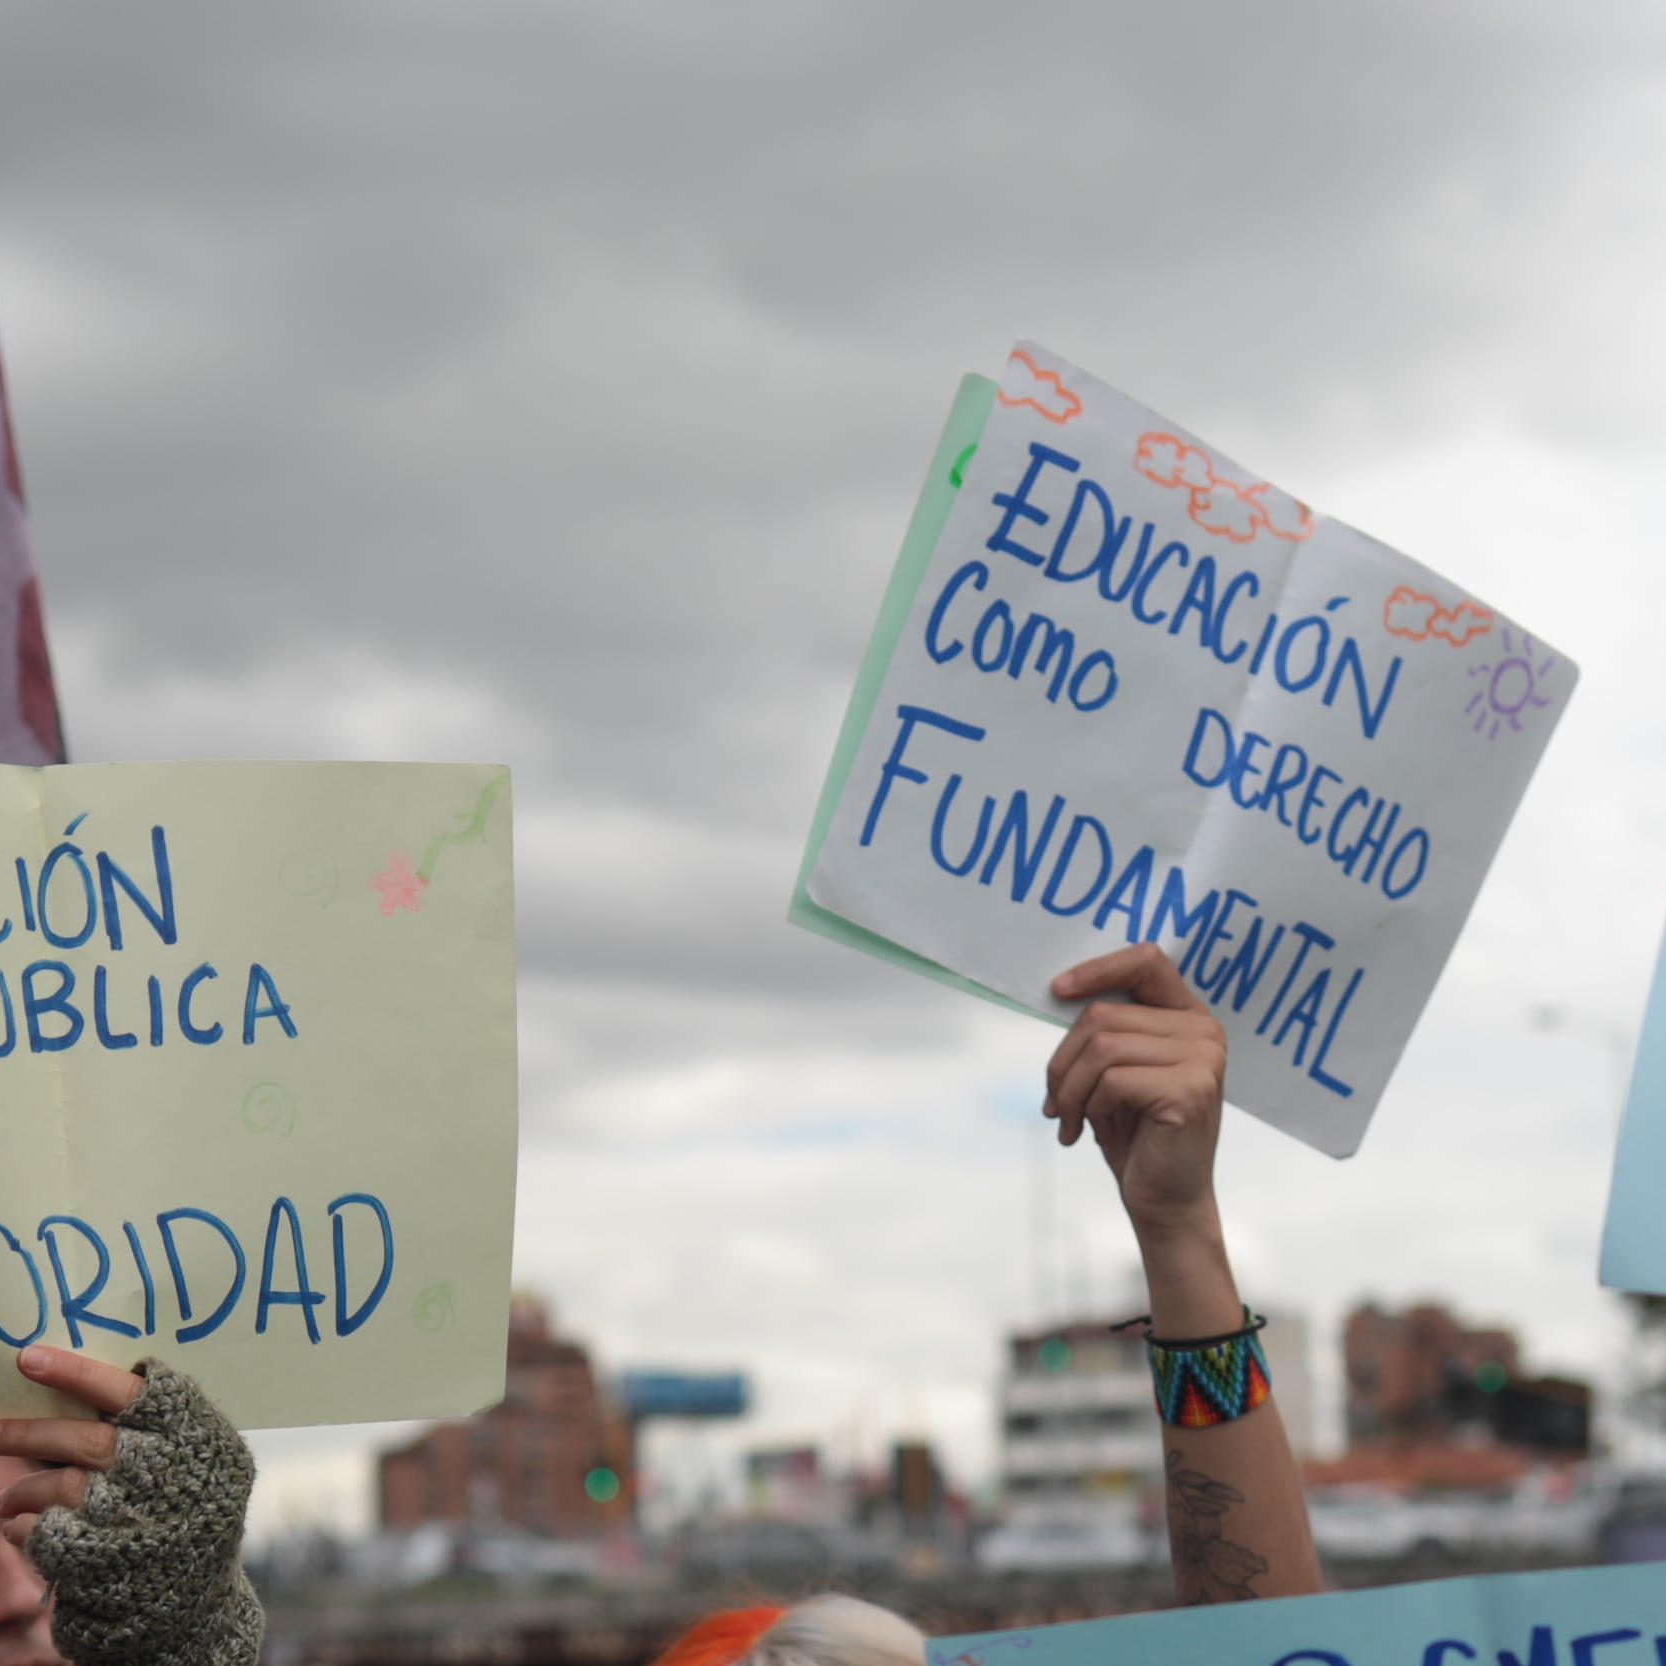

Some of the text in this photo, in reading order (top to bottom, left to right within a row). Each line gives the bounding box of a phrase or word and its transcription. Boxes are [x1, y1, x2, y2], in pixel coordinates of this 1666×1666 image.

[985, 442, 1403, 741] EDUCACIÓN
[859, 704, 1366, 1100] FUNDAMENTAL
[1182, 706, 1431, 901] DERECHO
